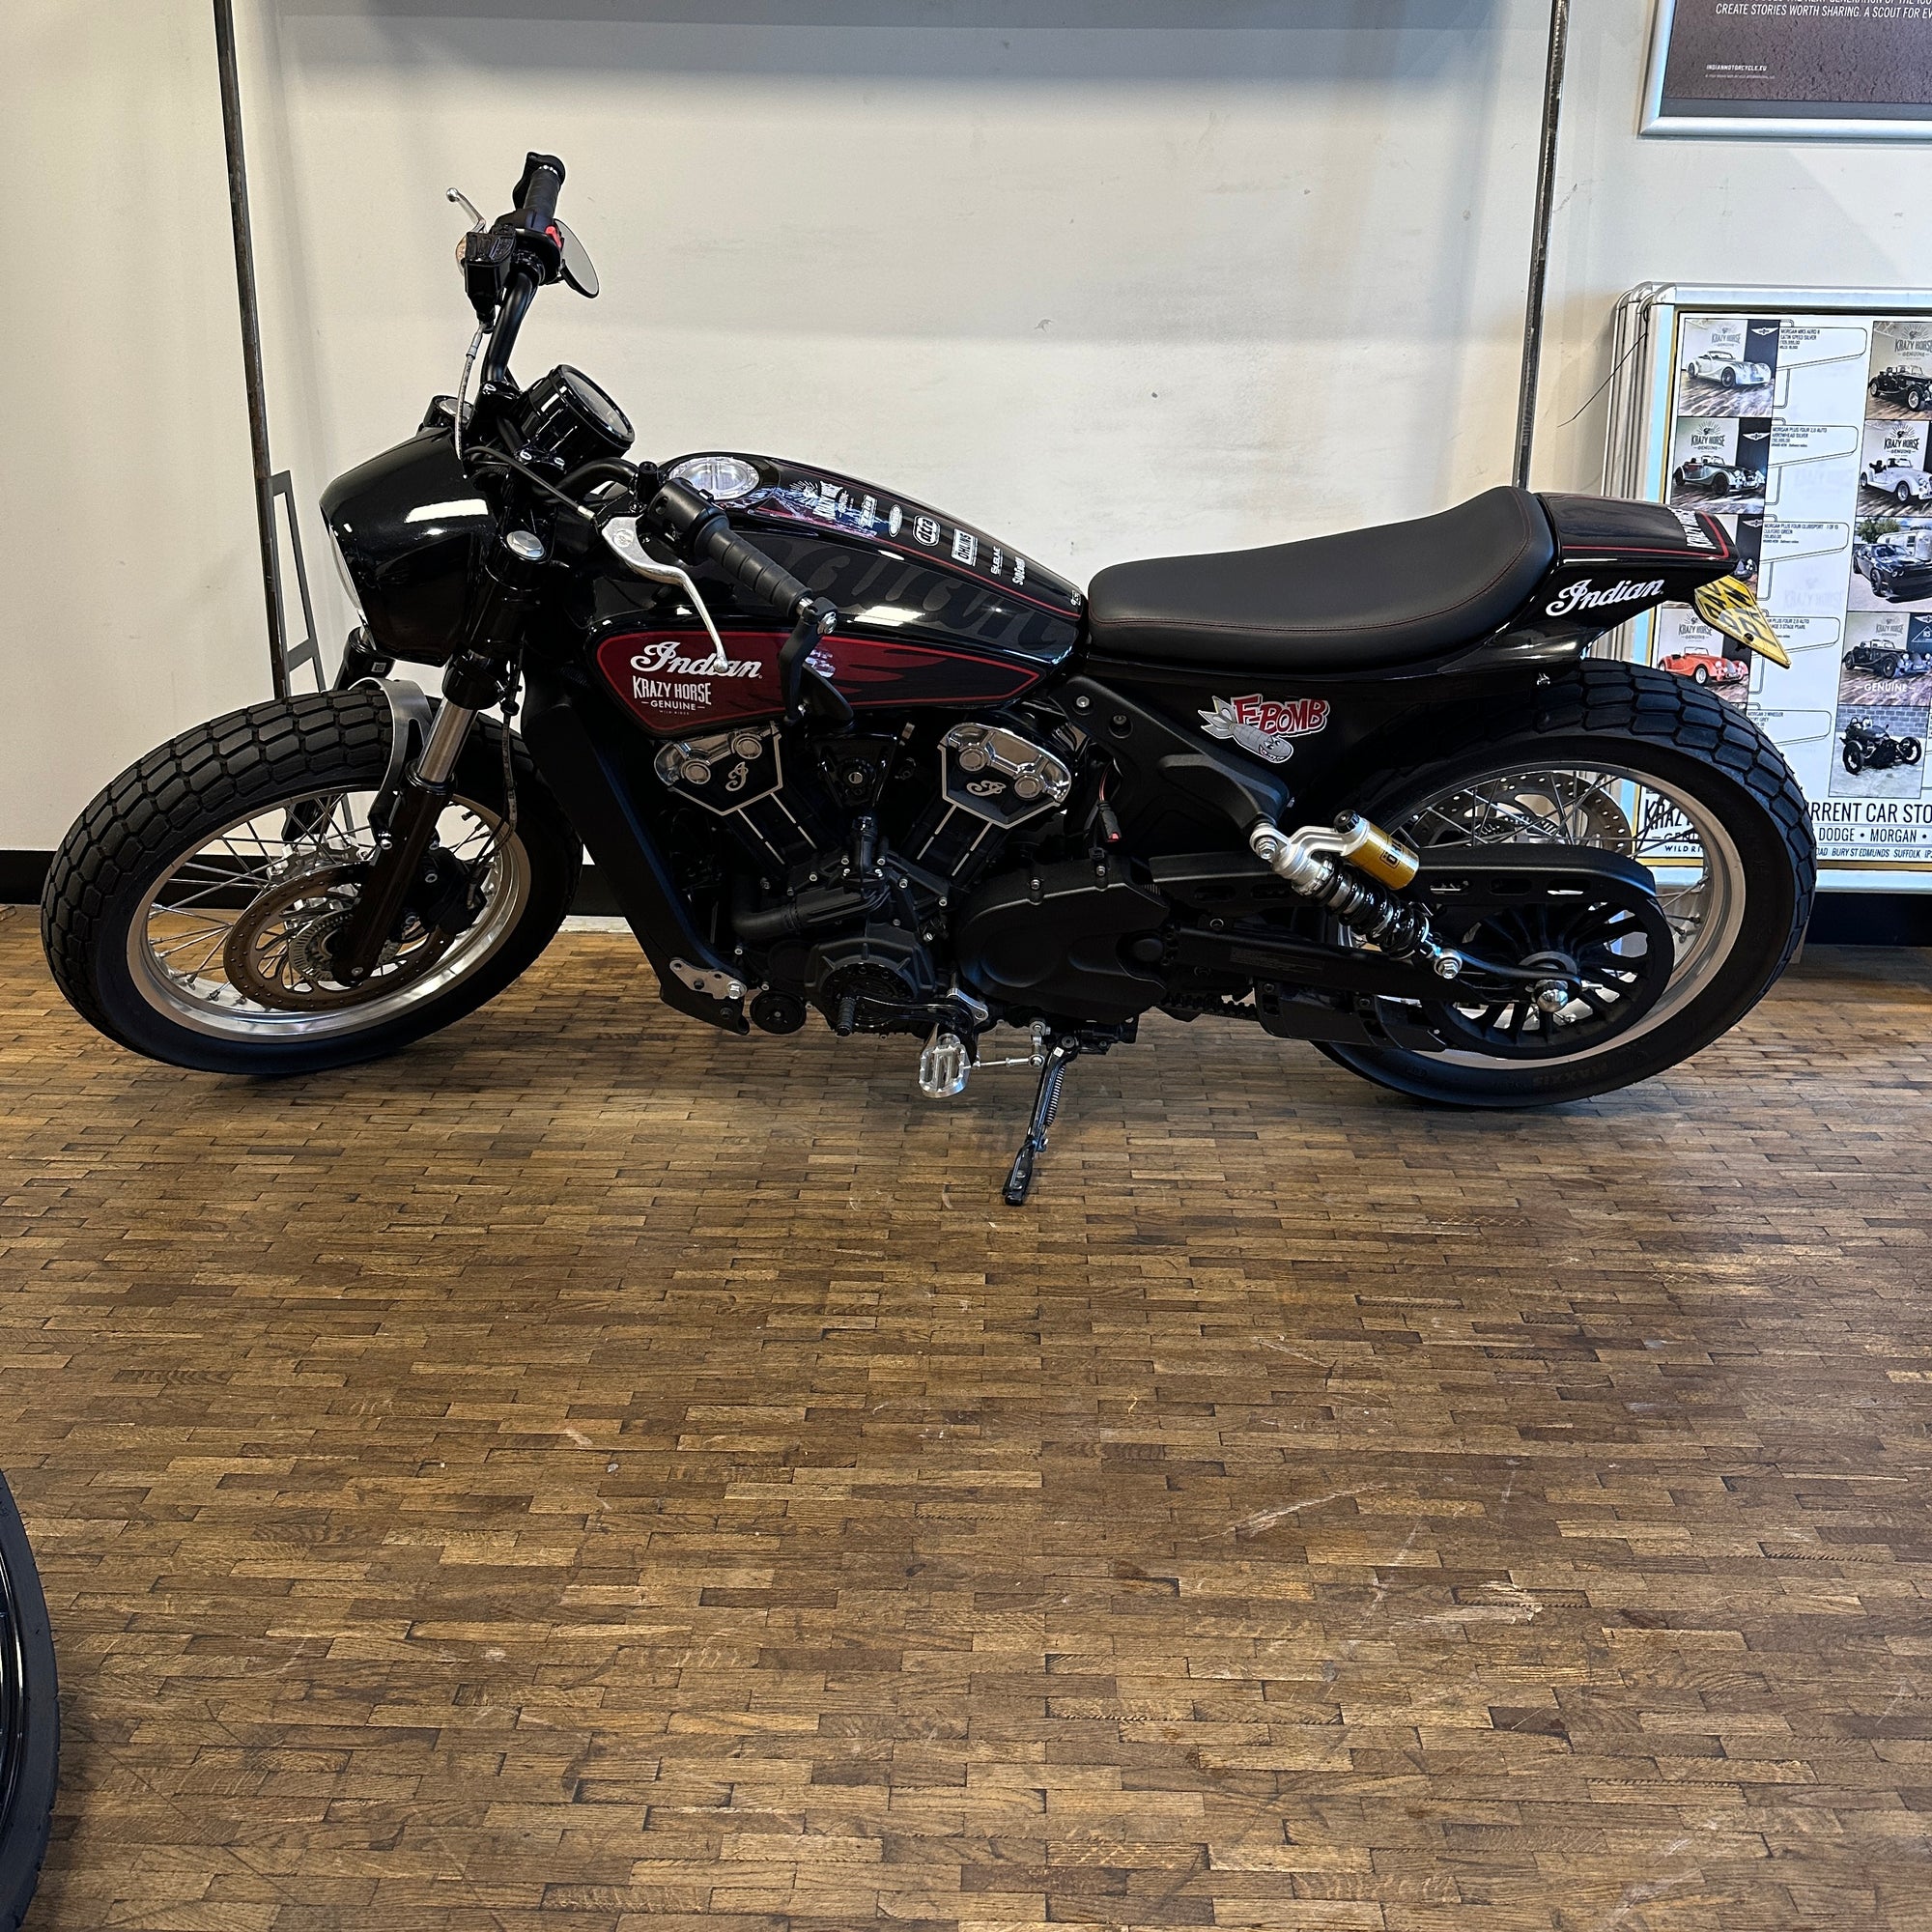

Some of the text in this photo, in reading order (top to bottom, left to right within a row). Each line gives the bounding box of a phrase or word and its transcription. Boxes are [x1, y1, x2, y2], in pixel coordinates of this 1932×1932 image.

[1716, 3, 1749, 14] CREATE
[1750, 4, 1787, 15] STORIES
[1789, 5, 1819, 16] WORTH
[1821, 6, 1861, 17] SHARING.
[1863, 7, 1870, 17] A
[1872, 7, 1901, 18] SCOUT
[1903, 8, 1920, 18] FOR
[1894, 339, 1915, 352] KRAZY
[1690, 435, 1725, 446] KRAZY HORSE
[1884, 438, 1919, 450] KRAZY HORSE
[919, 518, 934, 542] dtra
[1546, 579, 1664, 616] Indian
[1679, 624, 1695, 636] KRAZY
[631, 641, 762, 678] Indan
[633, 675, 712, 705] KRAZY HORSE
[1864, 683, 1908, 693] GENUINE
[650, 699, 696, 711] GENUINE
[1806, 803, 1861, 822] RRENT
[1865, 803, 1897, 823] CAR
[1819, 828, 1917, 842] DODGE MORGAN
[1832, 847, 1849, 857] BURY
[1849, 848, 1858, 857] ST
[1859, 848, 1890, 858] EDMUNDS
[1893, 849, 1921, 858] SUFFOLK
